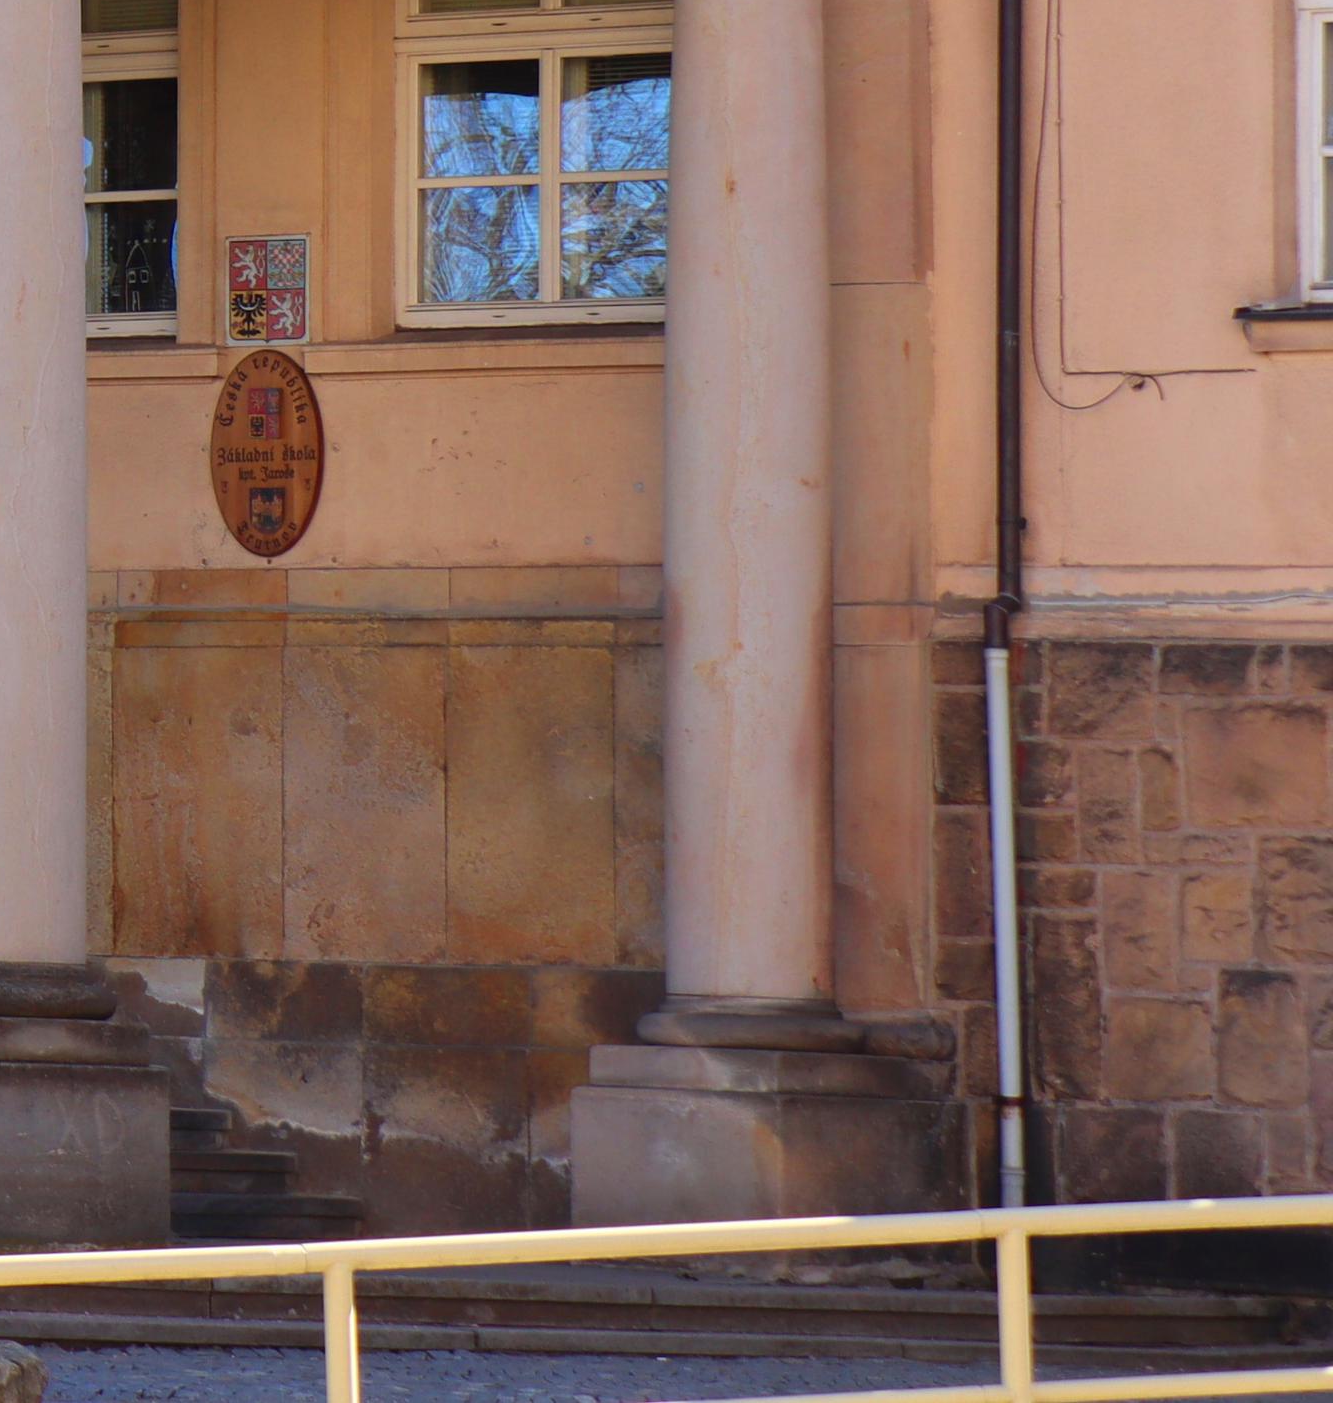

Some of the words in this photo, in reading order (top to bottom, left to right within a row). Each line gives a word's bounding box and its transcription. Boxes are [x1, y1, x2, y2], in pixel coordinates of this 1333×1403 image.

[216, 367, 247, 426] Česká
[252, 356, 308, 424] republika
[217, 447, 275, 466] Základní
[282, 444, 317, 461] škola
